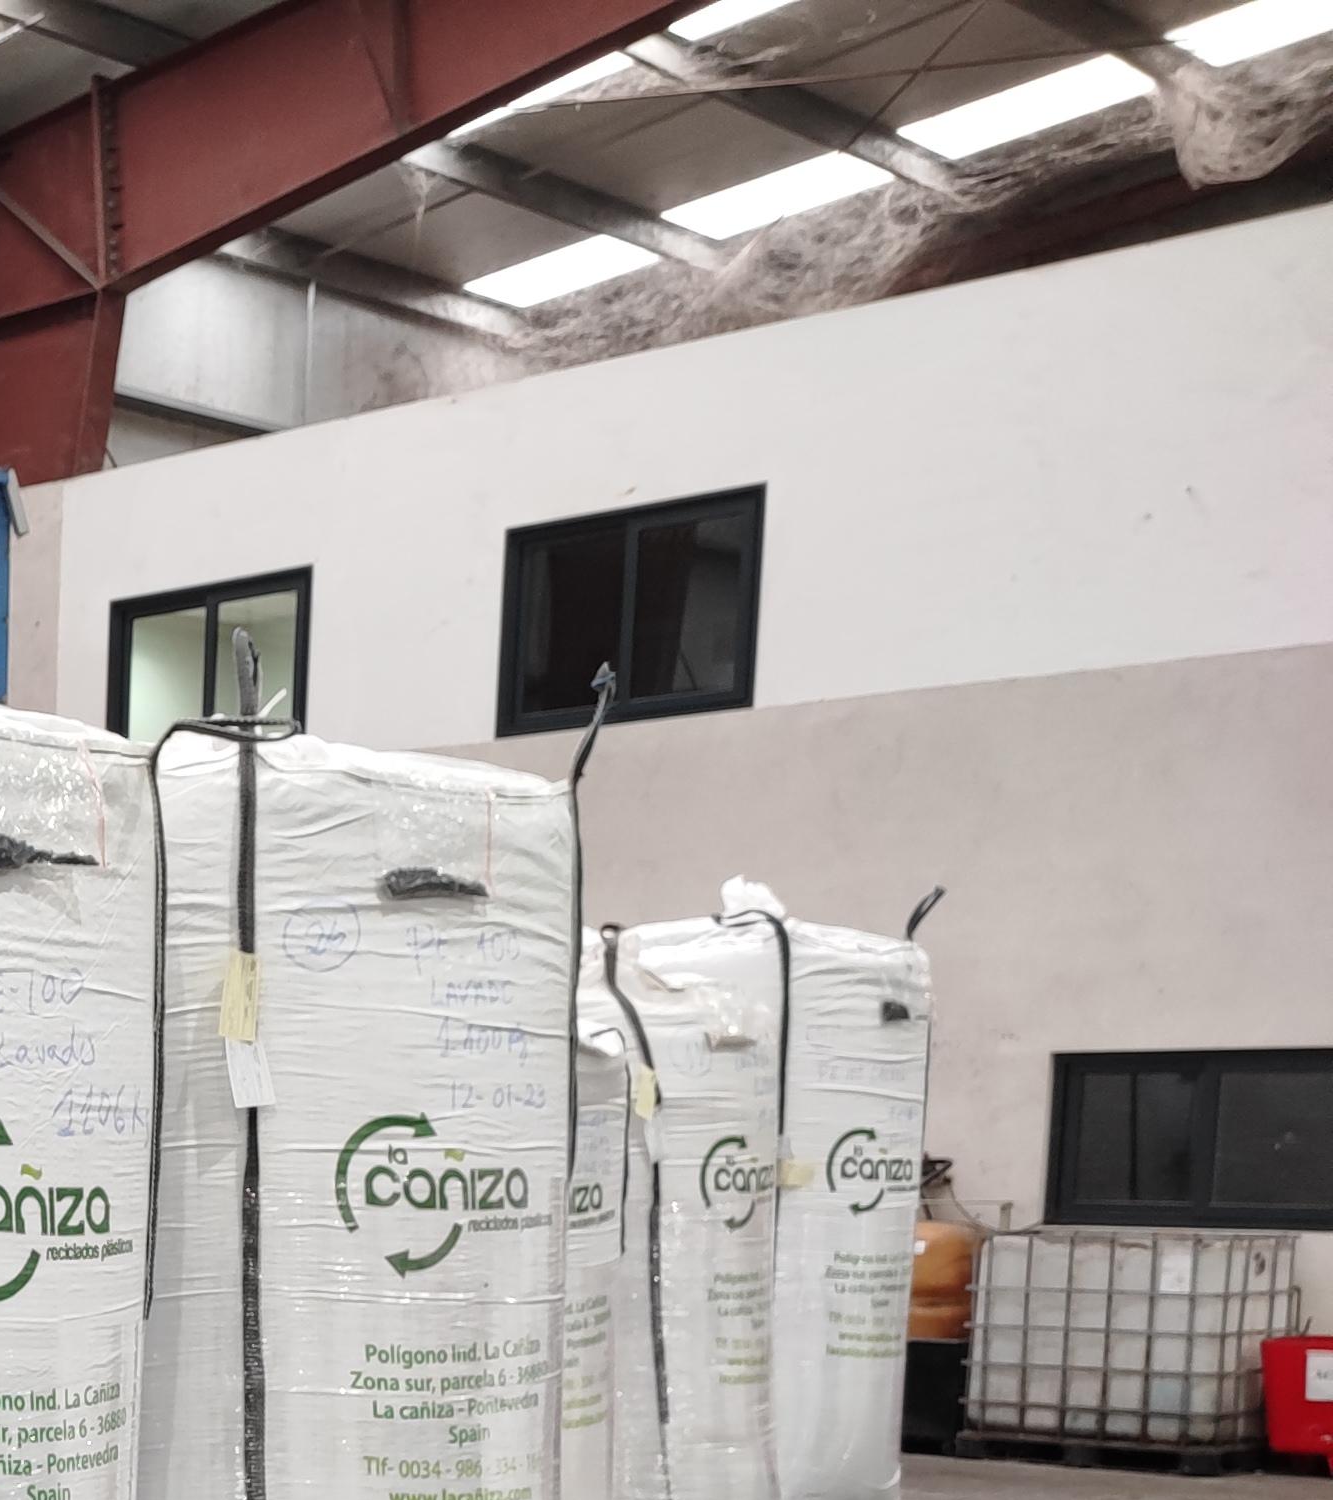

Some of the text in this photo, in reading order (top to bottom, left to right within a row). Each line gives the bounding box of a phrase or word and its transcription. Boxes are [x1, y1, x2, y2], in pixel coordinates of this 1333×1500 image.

[388, 1144, 409, 1165] la
[365, 1148, 530, 1211] cañiza
[365, 1343, 448, 1369] Polígono
[349, 1370, 400, 1392] Zona
[404, 1378, 437, 1395] sur,
[440, 1369, 495, 1396] parcela
[30, 1388, 61, 1412] Ind.
[64, 1388, 81, 1410] La
[84, 1381, 121, 1407] Cañiza
[372, 1400, 395, 1420] La
[399, 1401, 455, 1420] cañiza
[17, 1419, 76, 1449] parcela
[78, 1418, 88, 1439] 6
[448, 1424, 491, 1449] Spain
[47, 1443, 119, 1475] Pontevedra
[398, 1459, 442, 1479] 0034
